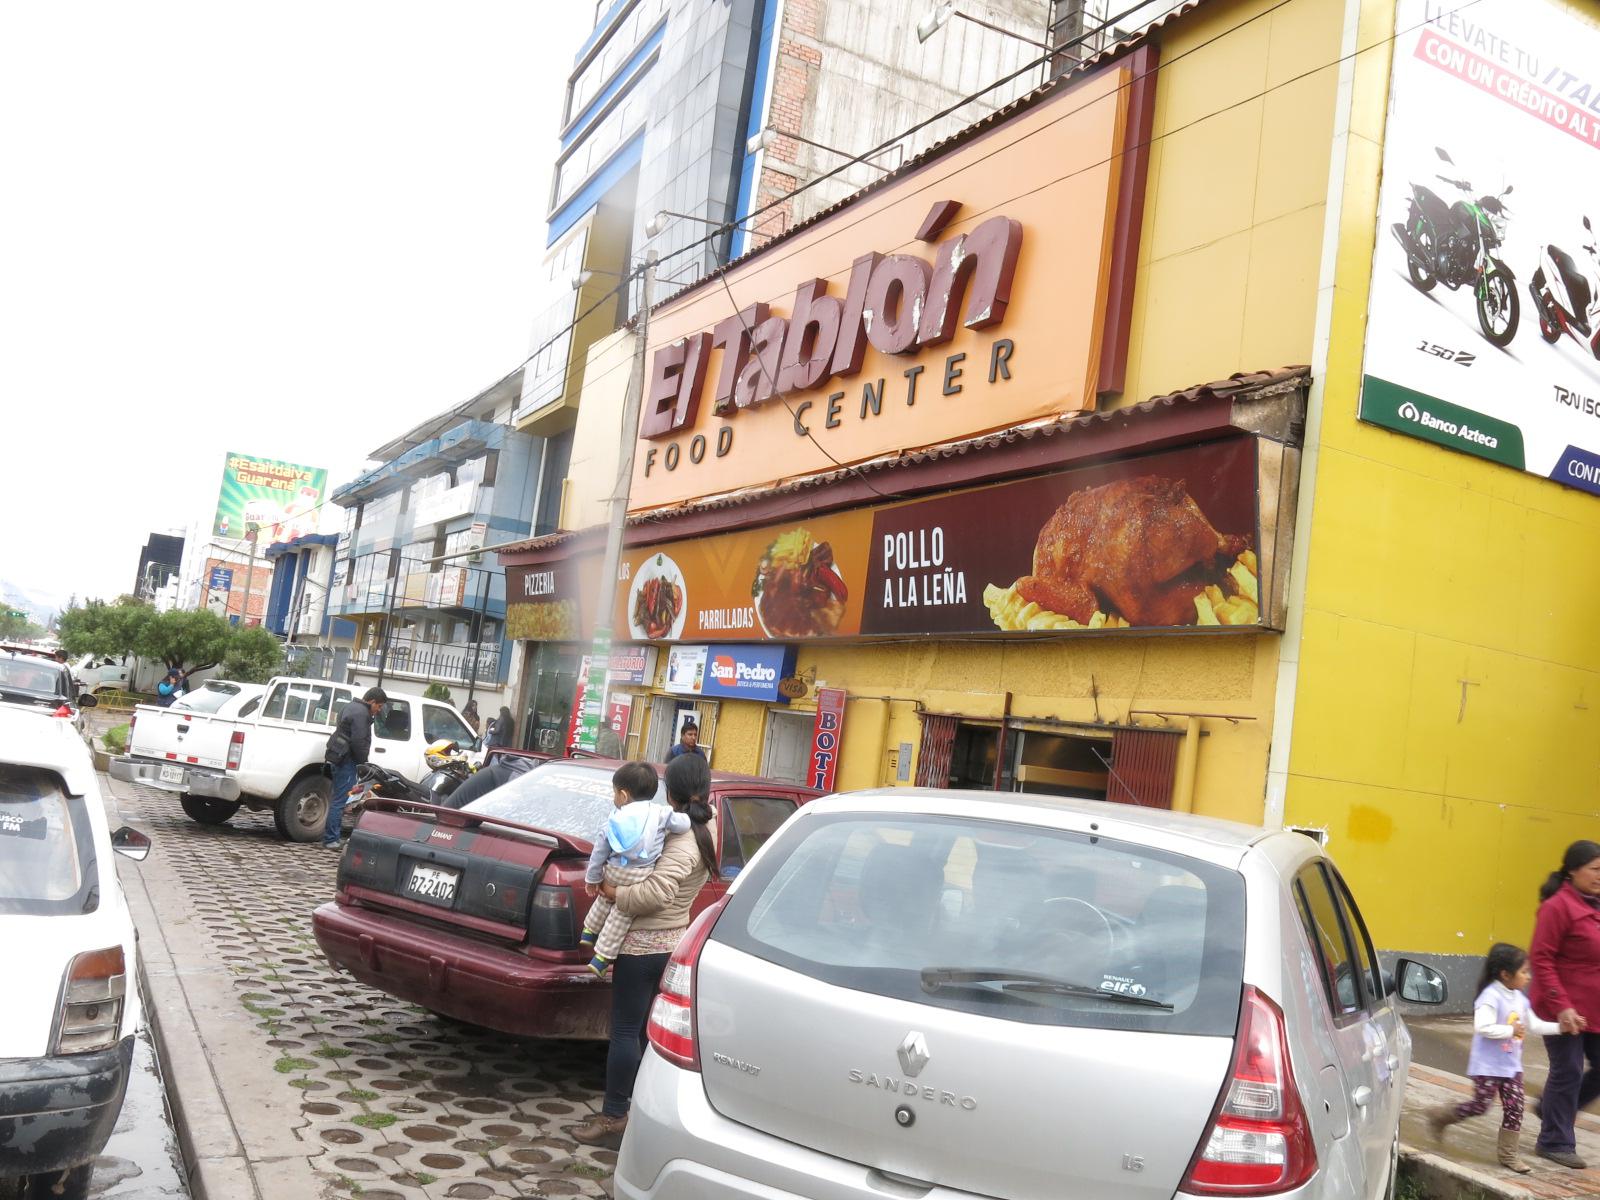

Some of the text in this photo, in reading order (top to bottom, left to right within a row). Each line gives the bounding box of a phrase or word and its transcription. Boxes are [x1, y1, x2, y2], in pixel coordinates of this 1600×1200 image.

[1515, 46, 1539, 77] TU
[1424, 38, 1465, 73] CON
[1467, 60, 1495, 88] UN
[1496, 74, 1568, 125] CRÉDITO
[1568, 112, 1589, 137] AL
[640, 200, 1024, 440] El Tablón
[643, 338, 1015, 478] FOOD CENTER
[1420, 411, 1498, 449] Banco Azteca
[883, 526, 944, 572] POLLO
[524, 571, 555, 596] PIZZERIA
[883, 567, 967, 609] A LA LEÑA
[698, 607, 754, 631] PARRILLADAS
[710, 661, 776, 682] San Pedro
[3, 822, 21, 831] FM
[1103, 974, 1135, 984] RENAULT
[713, 1051, 761, 1076] RENAULT
[848, 1068, 978, 1111] SANDERO
